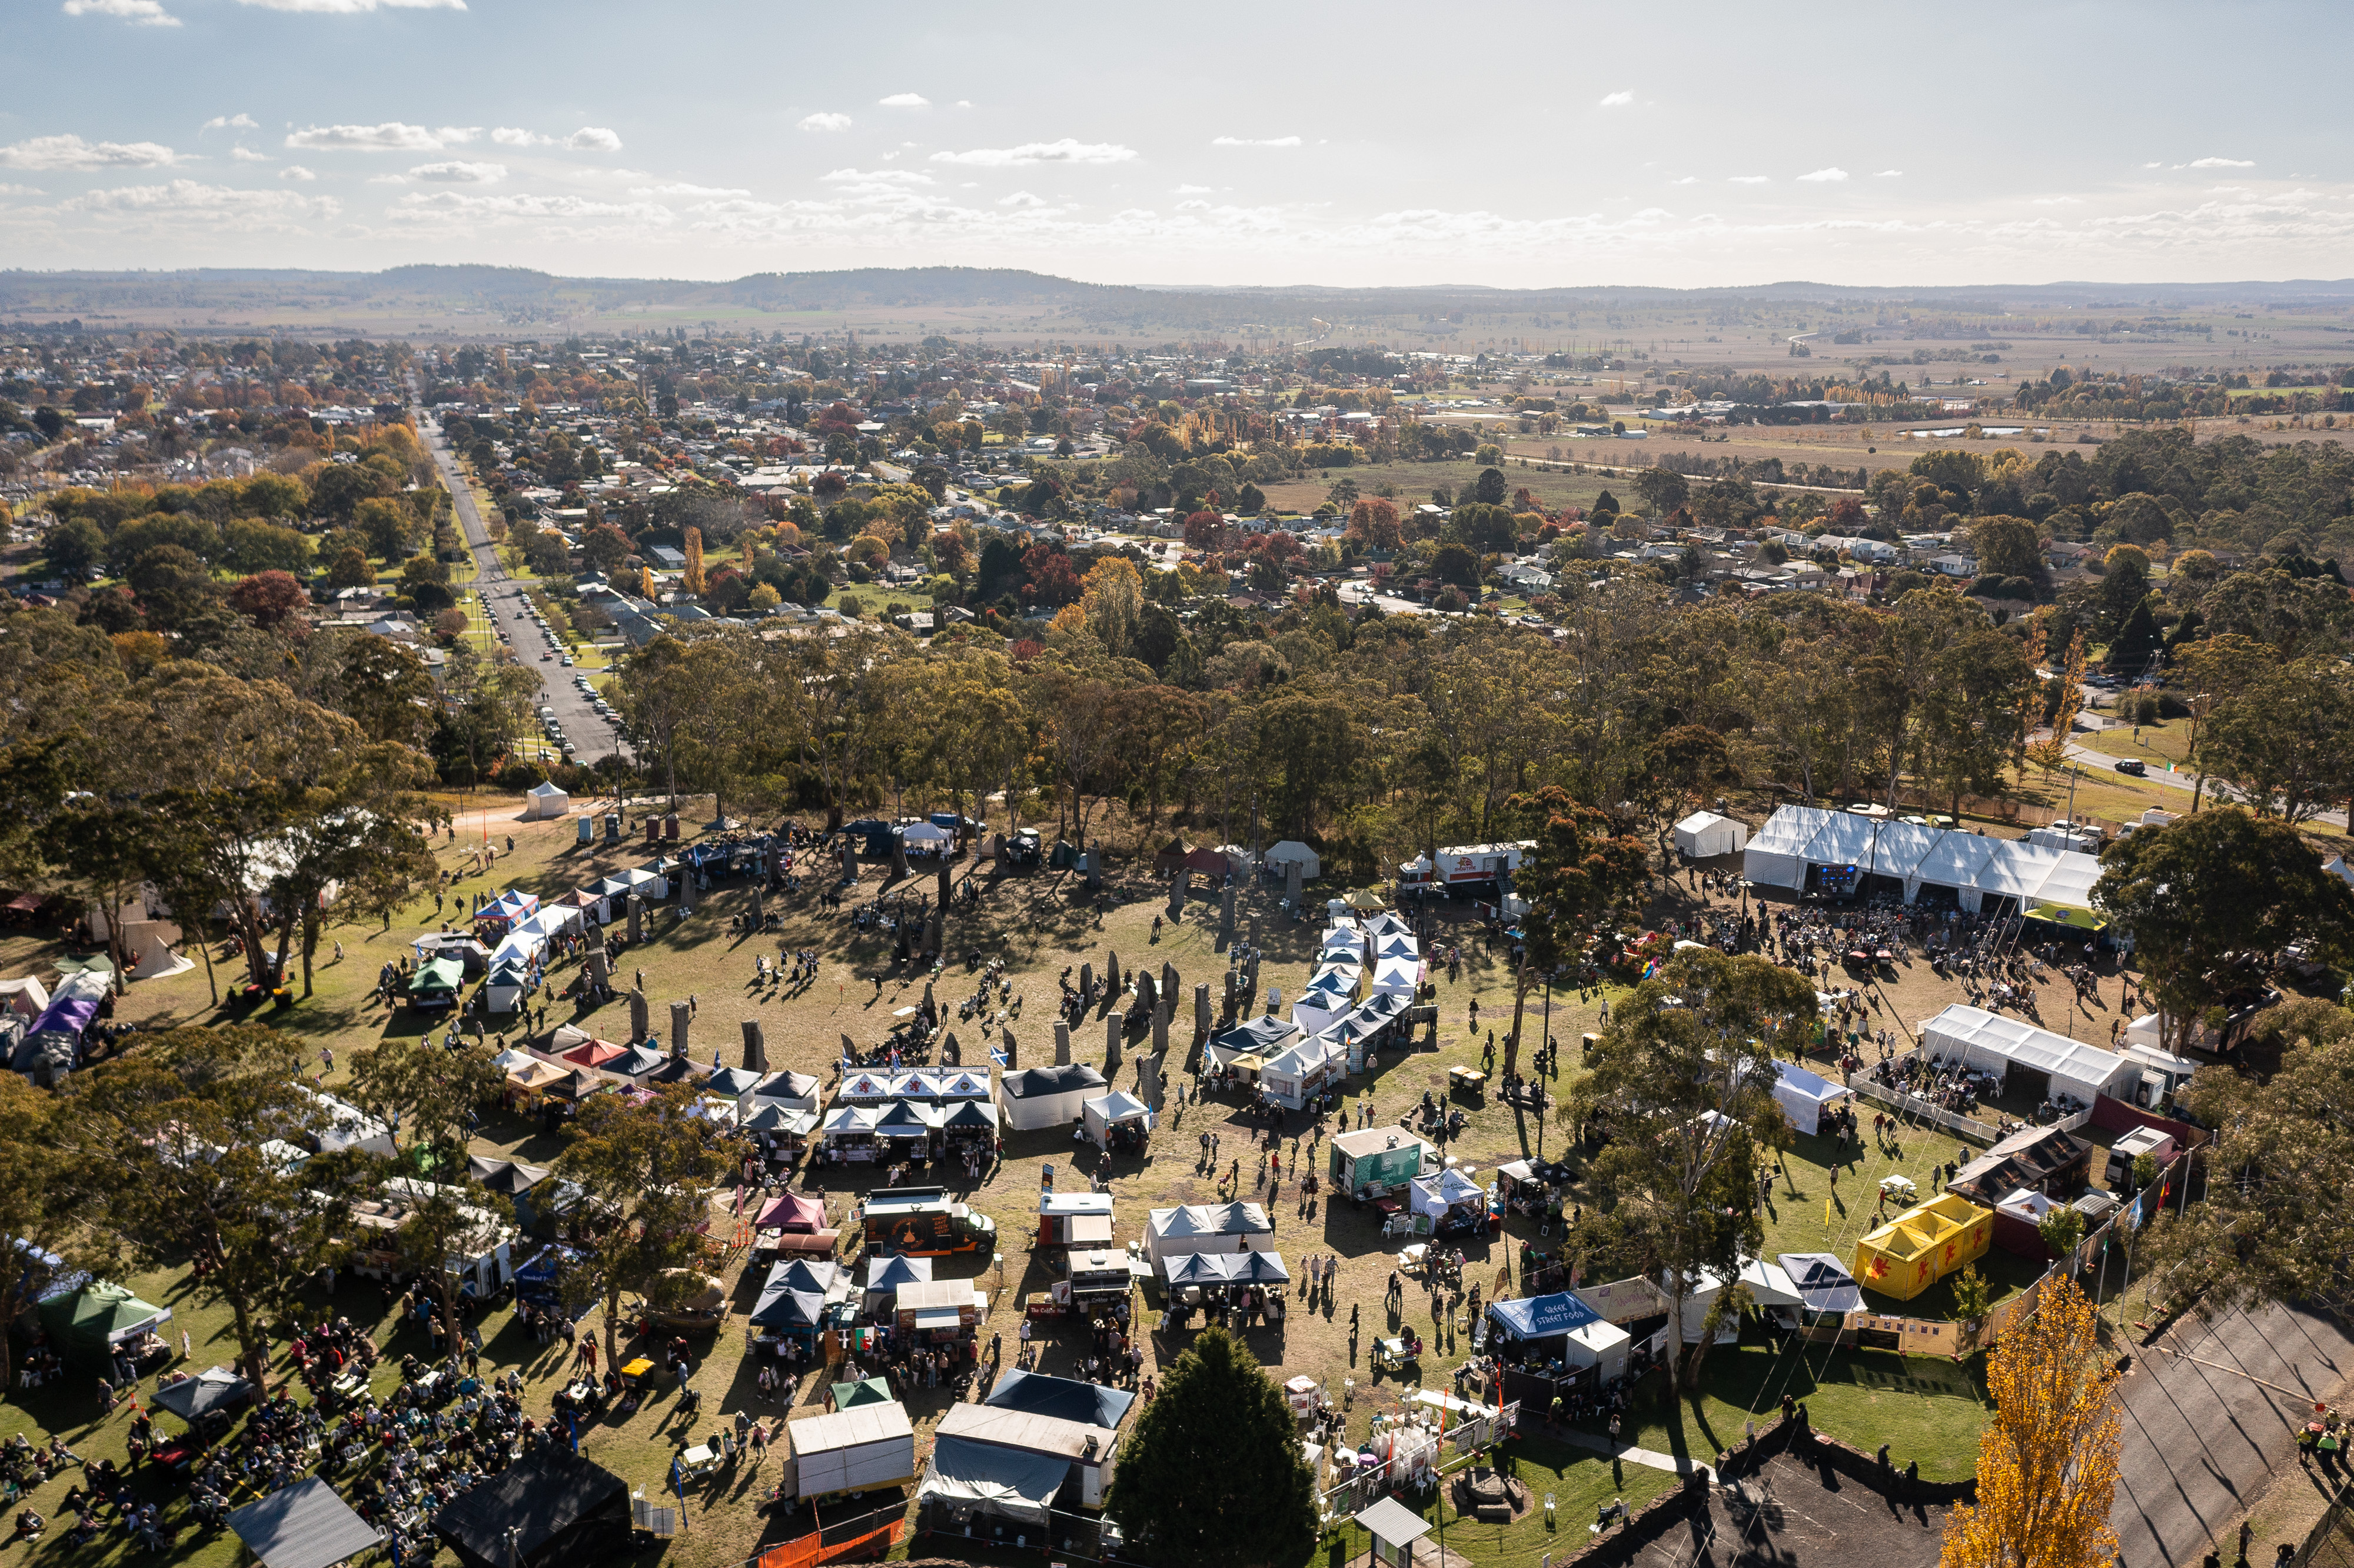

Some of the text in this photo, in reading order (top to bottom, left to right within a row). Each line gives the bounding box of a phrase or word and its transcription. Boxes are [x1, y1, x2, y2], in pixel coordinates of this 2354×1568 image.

[1502, 1304, 1528, 1326] STREET FOOD
[1515, 1304, 1528, 1316] GREEK
[1544, 1303, 1568, 1314] GREEK
[1537, 1310, 1585, 1326] STREET FOOD
